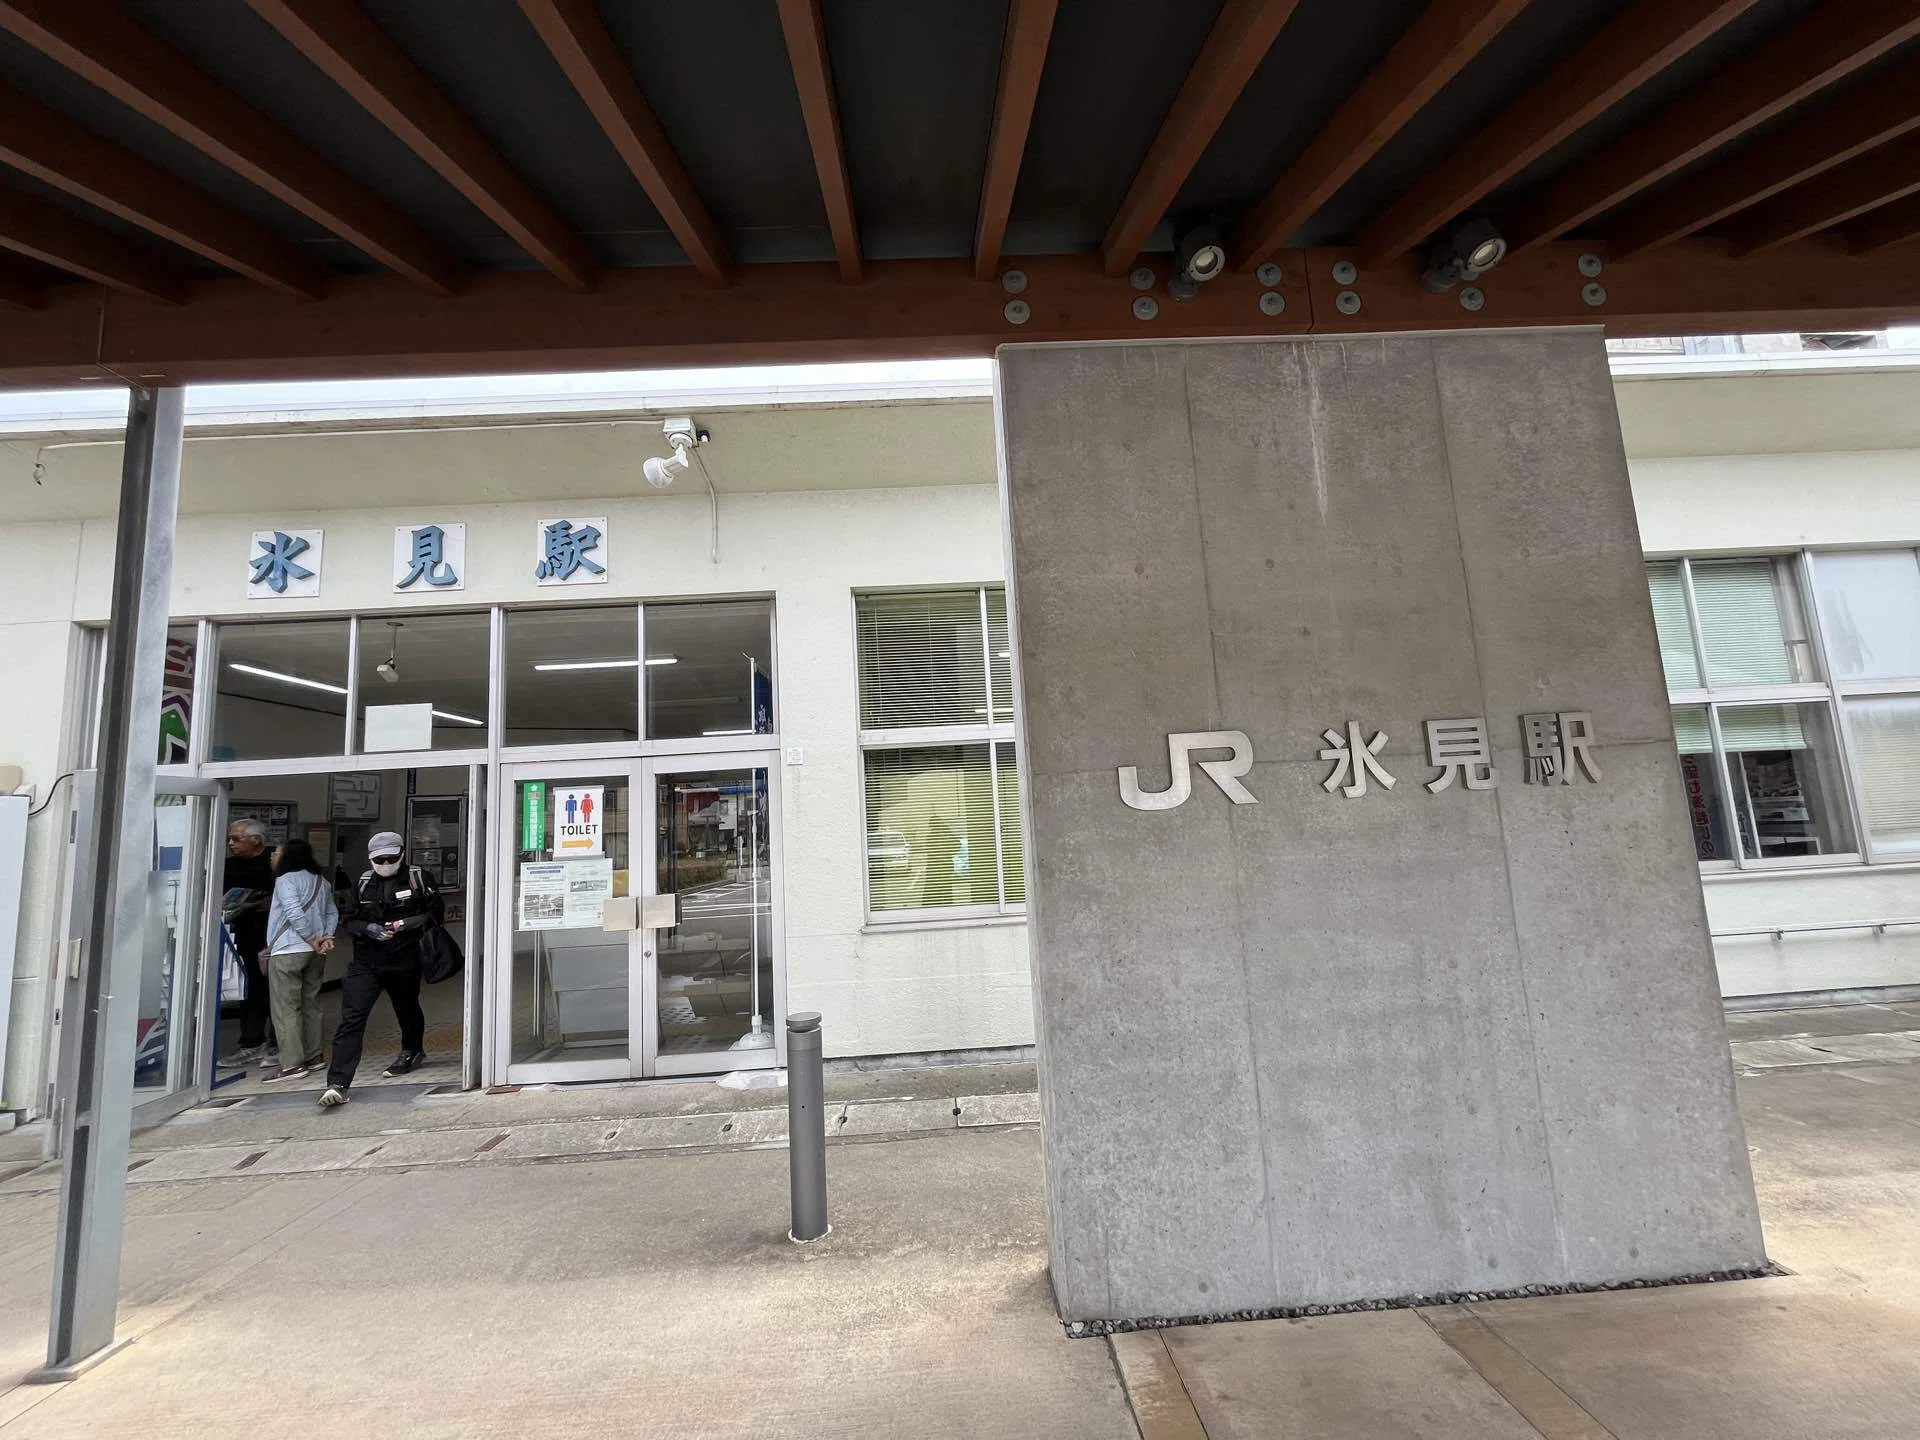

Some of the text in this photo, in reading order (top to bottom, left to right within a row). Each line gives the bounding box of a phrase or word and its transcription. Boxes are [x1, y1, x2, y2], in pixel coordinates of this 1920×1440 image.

[249, 519, 606, 593] 氷見駅
[1117, 712, 1603, 811] JR 氷見駅
[560, 824, 598, 836] TOILET
